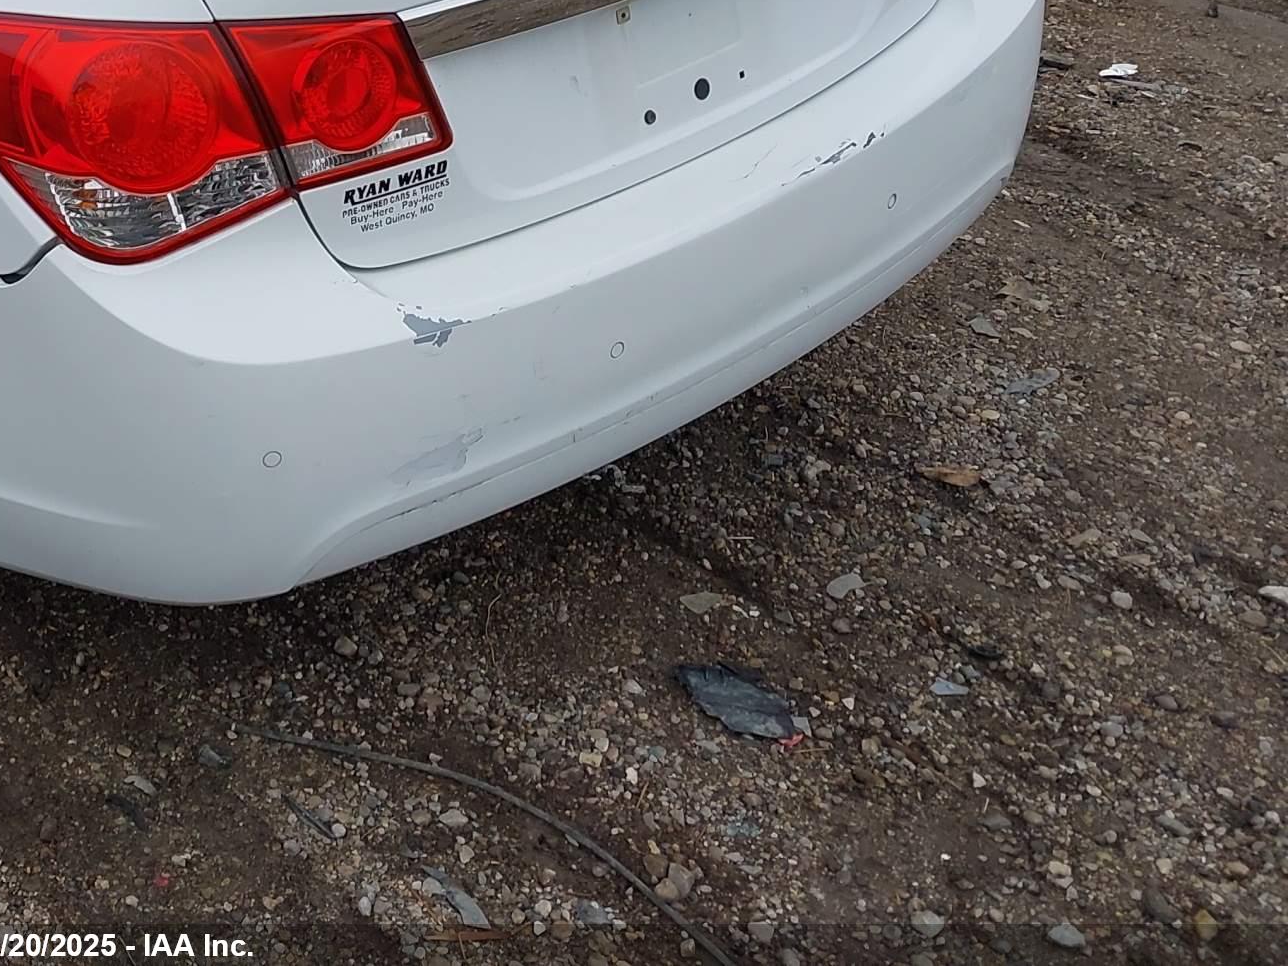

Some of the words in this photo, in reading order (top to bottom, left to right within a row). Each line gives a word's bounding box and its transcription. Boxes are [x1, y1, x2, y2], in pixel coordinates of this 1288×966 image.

[342, 198, 389, 219] PRE-OWNED
[389, 191, 411, 204] CARS
[420, 177, 451, 195] TRUCKS
[343, 178, 392, 206] RYAN
[397, 159, 448, 189] WARD
[350, 205, 394, 225] Buy-Here
[401, 190, 443, 210] Pay-Here
[360, 221, 383, 233] West
[385, 210, 417, 226] Quincy,
[420, 202, 435, 215] MO
